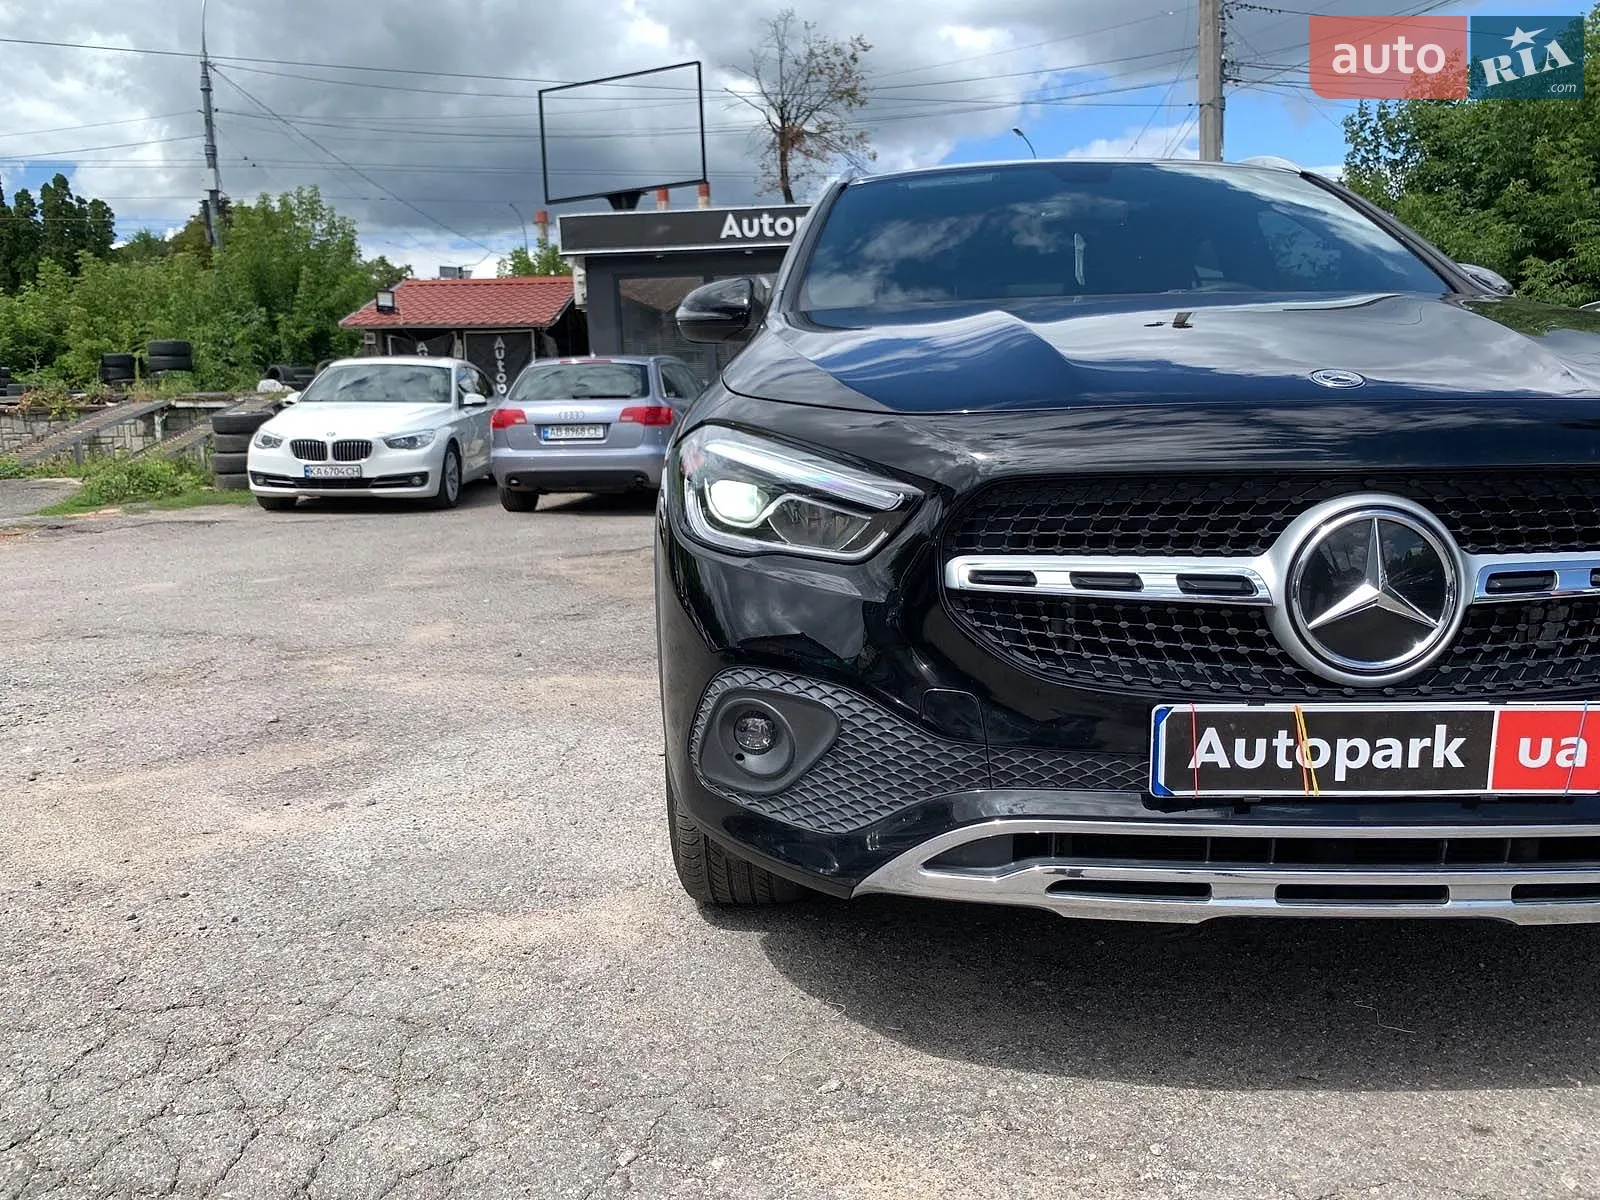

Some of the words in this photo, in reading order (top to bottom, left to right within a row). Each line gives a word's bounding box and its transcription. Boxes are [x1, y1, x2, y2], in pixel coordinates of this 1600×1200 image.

[324, 467, 345, 476] 6704
[346, 467, 360, 476] CH
[1187, 724, 1466, 782] Autopark
[1517, 736, 1588, 768] ua
